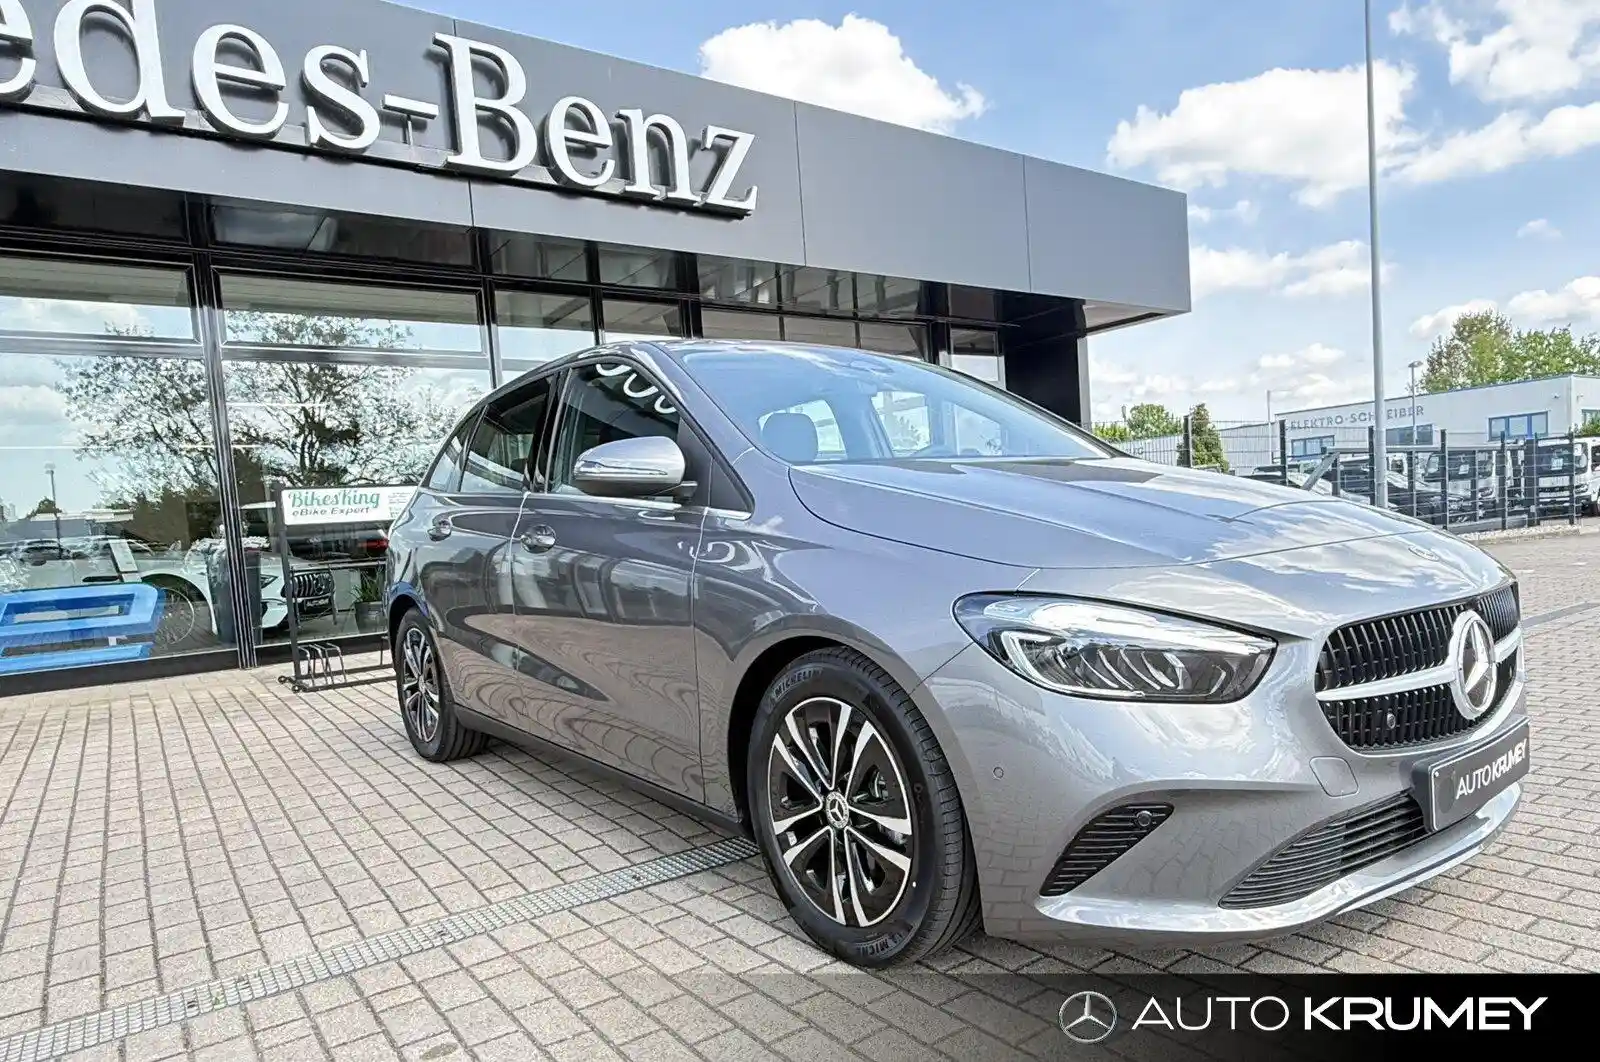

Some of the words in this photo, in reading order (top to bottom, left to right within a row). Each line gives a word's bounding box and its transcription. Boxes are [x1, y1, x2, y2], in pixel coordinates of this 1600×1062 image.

[1291, 405, 1424, 430] ELEKTRO-SCHEIBER
[331, 506, 370, 516] Expert
[1455, 765, 1491, 800] AUTO
[1492, 738, 1527, 781] KRUMEY
